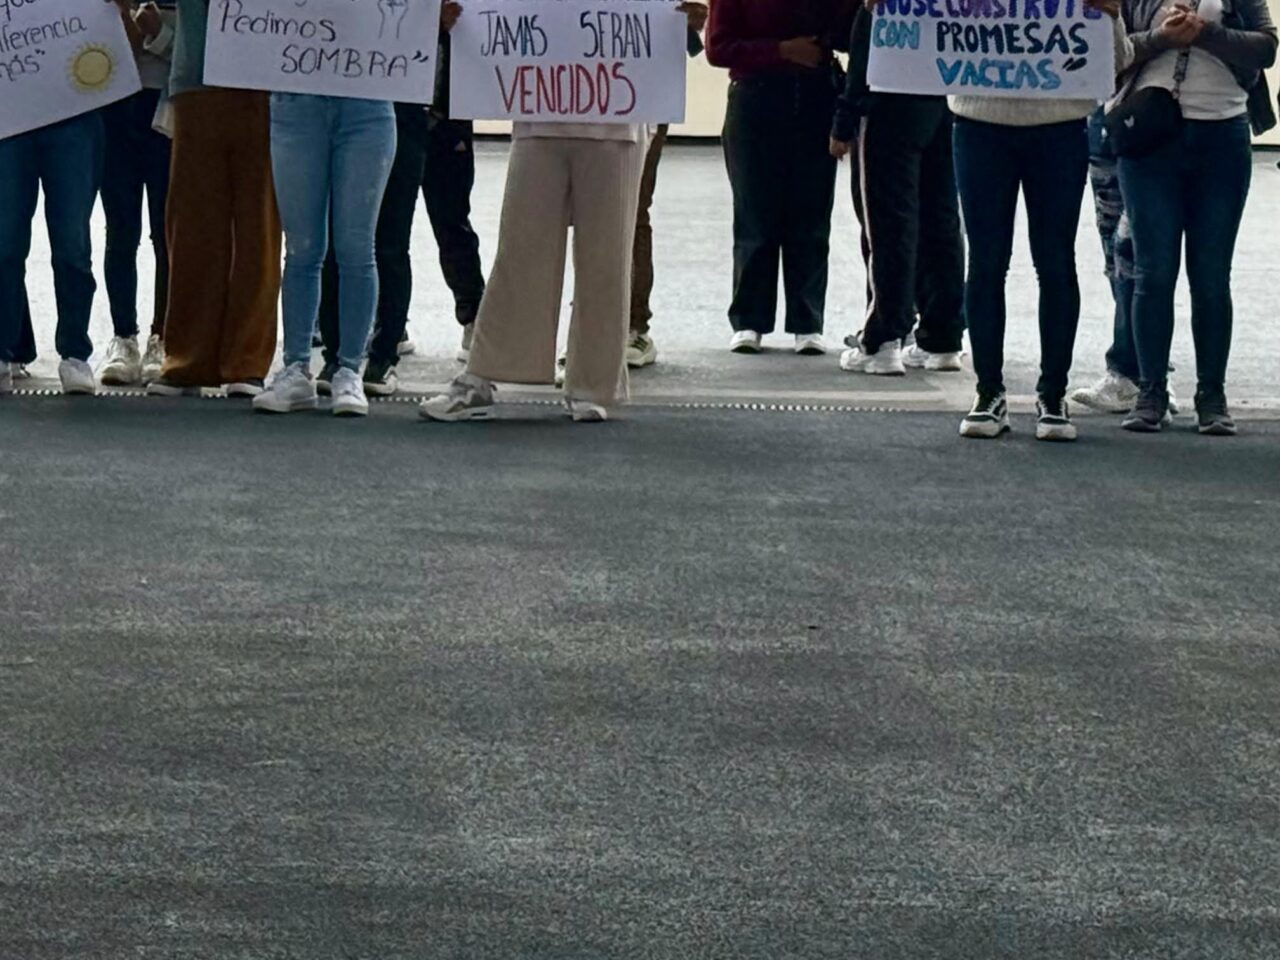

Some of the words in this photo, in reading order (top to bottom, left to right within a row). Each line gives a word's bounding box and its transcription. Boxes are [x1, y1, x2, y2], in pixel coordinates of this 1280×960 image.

[478, 10, 549, 57] JAMAS
[873, 17, 920, 50] CON
[936, 20, 1090, 55] PROMESAS
[495, 62, 637, 117] VENCIDOS
